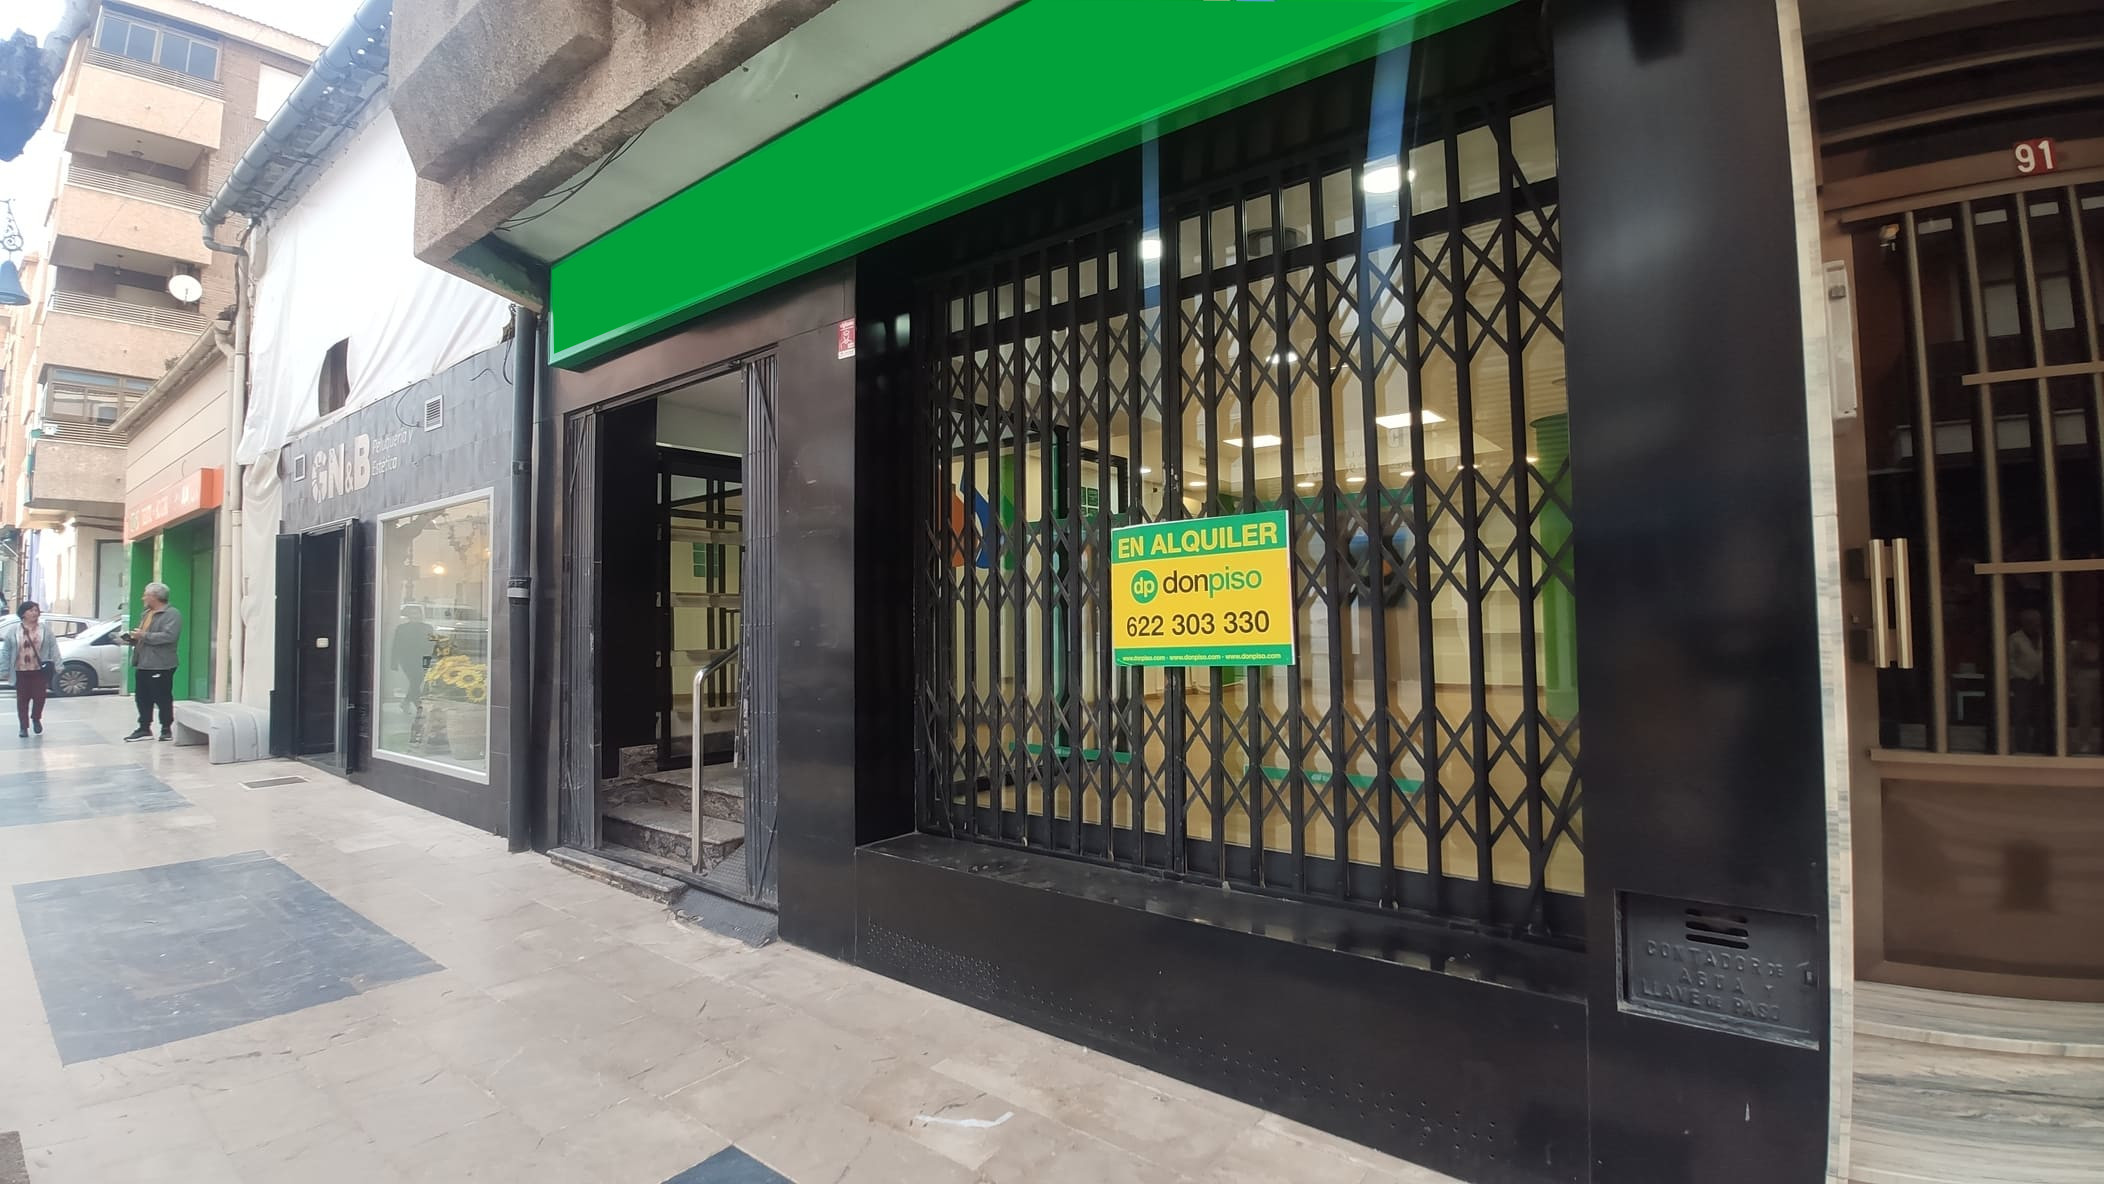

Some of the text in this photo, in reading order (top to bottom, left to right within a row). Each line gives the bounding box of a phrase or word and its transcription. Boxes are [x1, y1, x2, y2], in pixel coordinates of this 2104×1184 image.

[2014, 139, 2054, 173] 91
[1118, 521, 1278, 559] EN ALQUILER
[1133, 565, 1263, 598] dp donpiso
[1126, 609, 1270, 637] 622 303 330
[1169, 653, 1221, 661] www.donpiso.com
[1225, 652, 1282, 661] www.donpiso.com
[1642, 977, 1701, 1006] LLAVE
